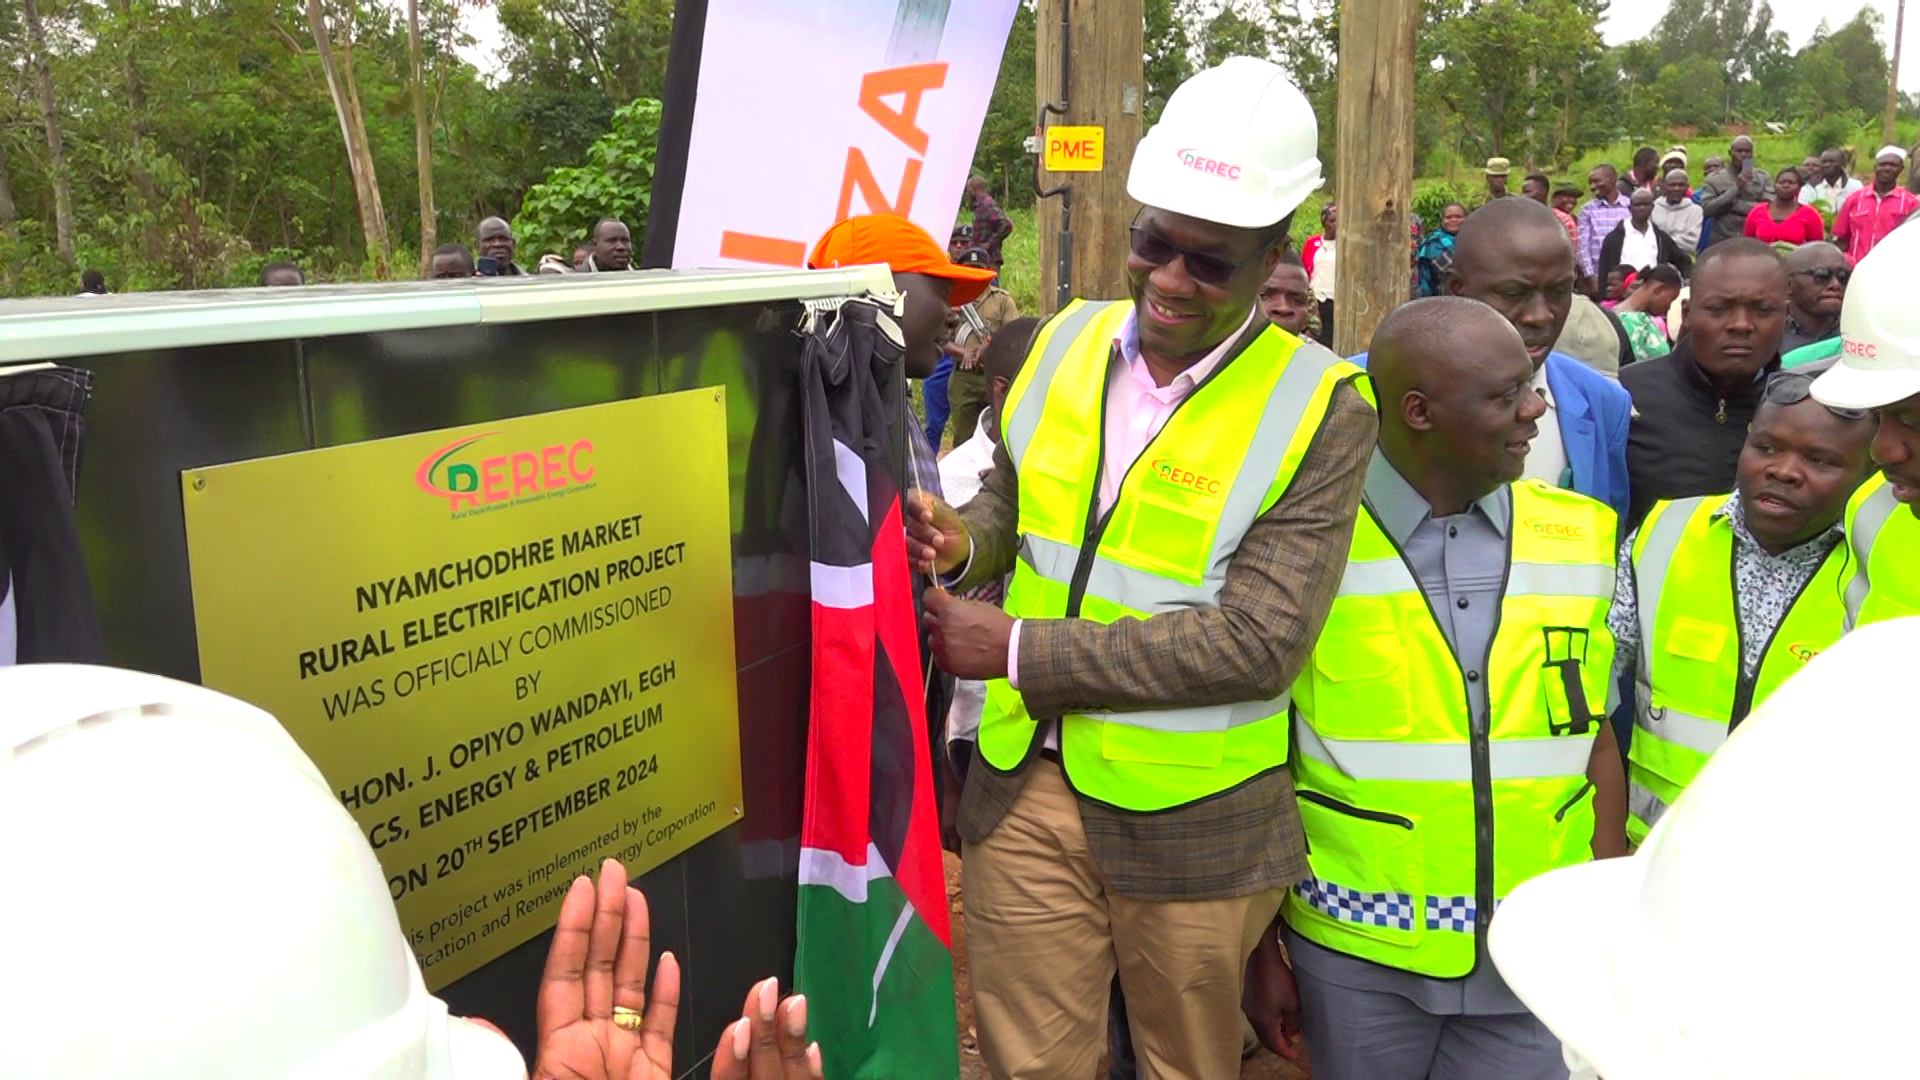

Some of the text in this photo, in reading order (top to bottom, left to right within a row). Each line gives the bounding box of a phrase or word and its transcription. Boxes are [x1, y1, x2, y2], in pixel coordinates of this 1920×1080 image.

[1051, 140, 1097, 159] PME
[1183, 153, 1241, 179] REREC
[1843, 340, 1876, 358] EREC
[446, 438, 596, 511] REREC
[1159, 465, 1221, 494] REREC
[298, 541, 686, 680] RURAL ELECTRIFICATION PROJECT
[355, 514, 643, 613] NYAMCHODHRE MARKET
[321, 585, 673, 722] WAS OFFICIALY COMMISSIONED
[515, 670, 543, 701] BY
[340, 660, 677, 811] HON. J. OPIYO WANDAYI, EGH
[369, 703, 664, 851] CS, ENERGY & PETROLEUM
[390, 863, 428, 902] ON
[487, 775, 611, 856] SEPTEMBER
[616, 754, 658, 793] 2024
[430, 895, 489, 943] project
[493, 879, 524, 903] was
[527, 823, 621, 887] implemented
[623, 816, 640, 837] by
[642, 804, 663, 825] the
[482, 907, 511, 938] and
[598, 839, 644, 869] Eergy
[647, 799, 717, 847] Corporation
